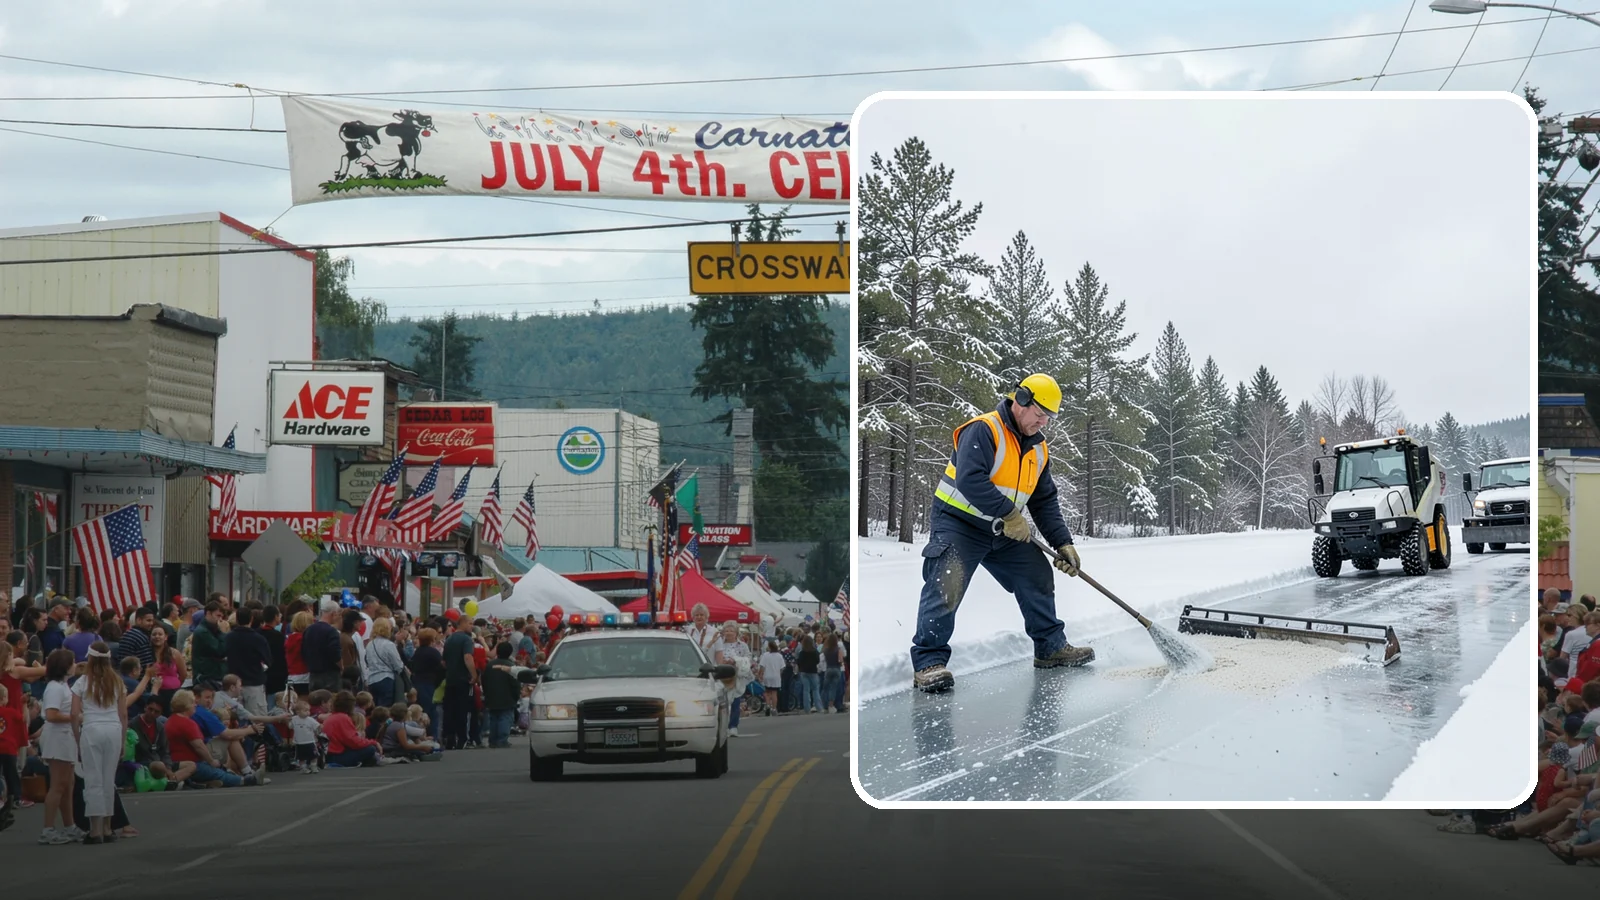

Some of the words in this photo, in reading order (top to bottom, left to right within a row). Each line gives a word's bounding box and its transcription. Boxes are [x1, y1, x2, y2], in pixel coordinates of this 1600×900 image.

[481, 141, 605, 193] JULY
[632, 150, 747, 197] 4th.
[696, 254, 850, 281] CROSSWA
[283, 380, 373, 420] ACE
[405, 409, 452, 422] CEDAR
[283, 421, 371, 437] Hardware
[353, 467, 385, 480] Simpl
[83, 485, 92, 495] St.
[95, 485, 124, 495] Vincent
[126, 486, 136, 495] de
[138, 486, 155, 495] Paul
[688, 526, 741, 535] CRNATION
[699, 535, 730, 544] GLASS
